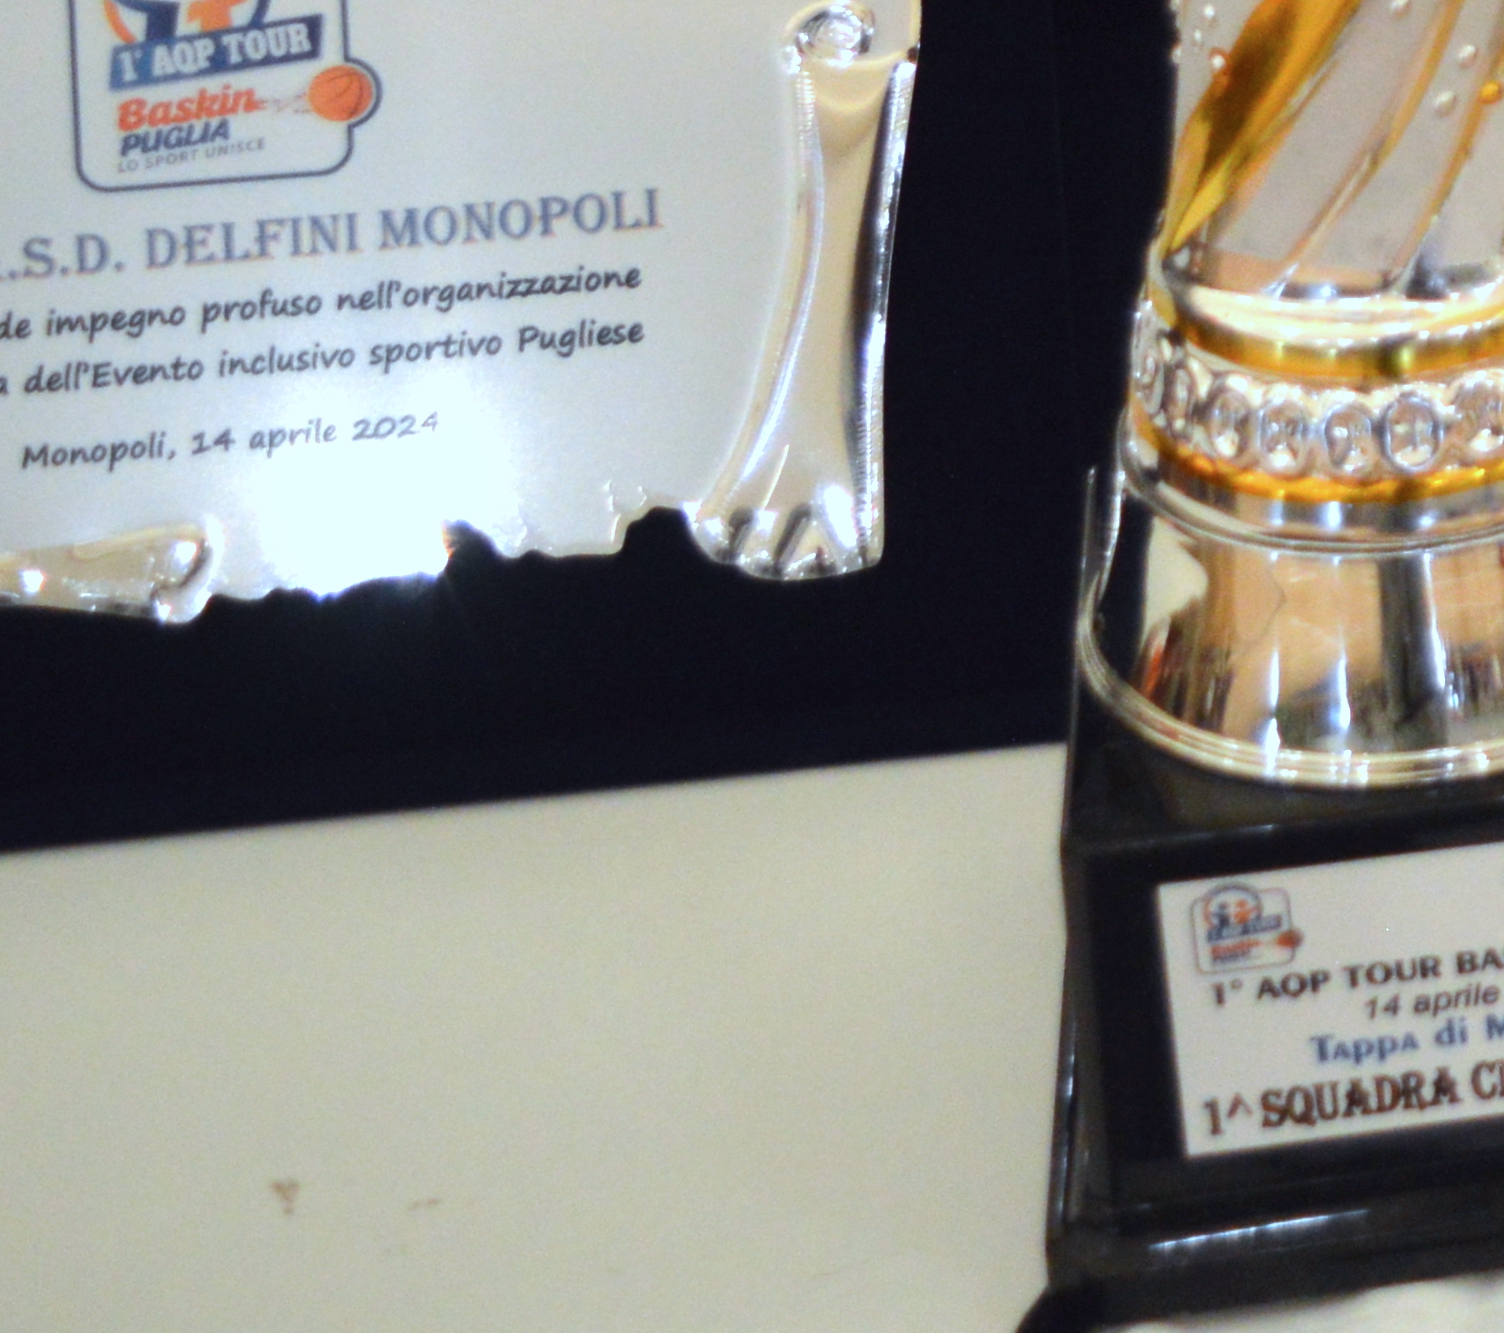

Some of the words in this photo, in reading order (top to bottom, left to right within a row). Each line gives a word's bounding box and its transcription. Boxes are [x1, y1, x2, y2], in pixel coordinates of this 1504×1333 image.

[152, 35, 216, 79] AQP
[224, 23, 313, 65] TOUR
[117, 83, 262, 132] Baskin
[117, 155, 140, 173] LO
[144, 148, 200, 171] SPORT
[205, 136, 267, 162] UNISCE
[120, 118, 231, 157] PUGLIA
[0, 232, 126, 281] .S.D.
[145, 210, 364, 271] DELFINI
[378, 188, 665, 251] MONOPOLI
[46, 305, 187, 344] impegno
[201, 288, 324, 333] profuso
[336, 264, 643, 316] nell'organizzazione
[24, 357, 205, 394] dell'Evento
[218, 342, 356, 380] inclusivo
[368, 324, 503, 373] sportivo
[517, 318, 645, 359] Pugliese
[20, 430, 177, 473] Monopoli,
[191, 427, 235, 456] 14
[249, 416, 338, 461] aprile
[352, 411, 441, 443] 2024
[1342, 958, 1443, 992] TOUR
[1365, 994, 1403, 1020] 14
[1412, 981, 1501, 1020] aprile
[1434, 1017, 1469, 1050] di
[1260, 1067, 1464, 1132] SQUADRA
